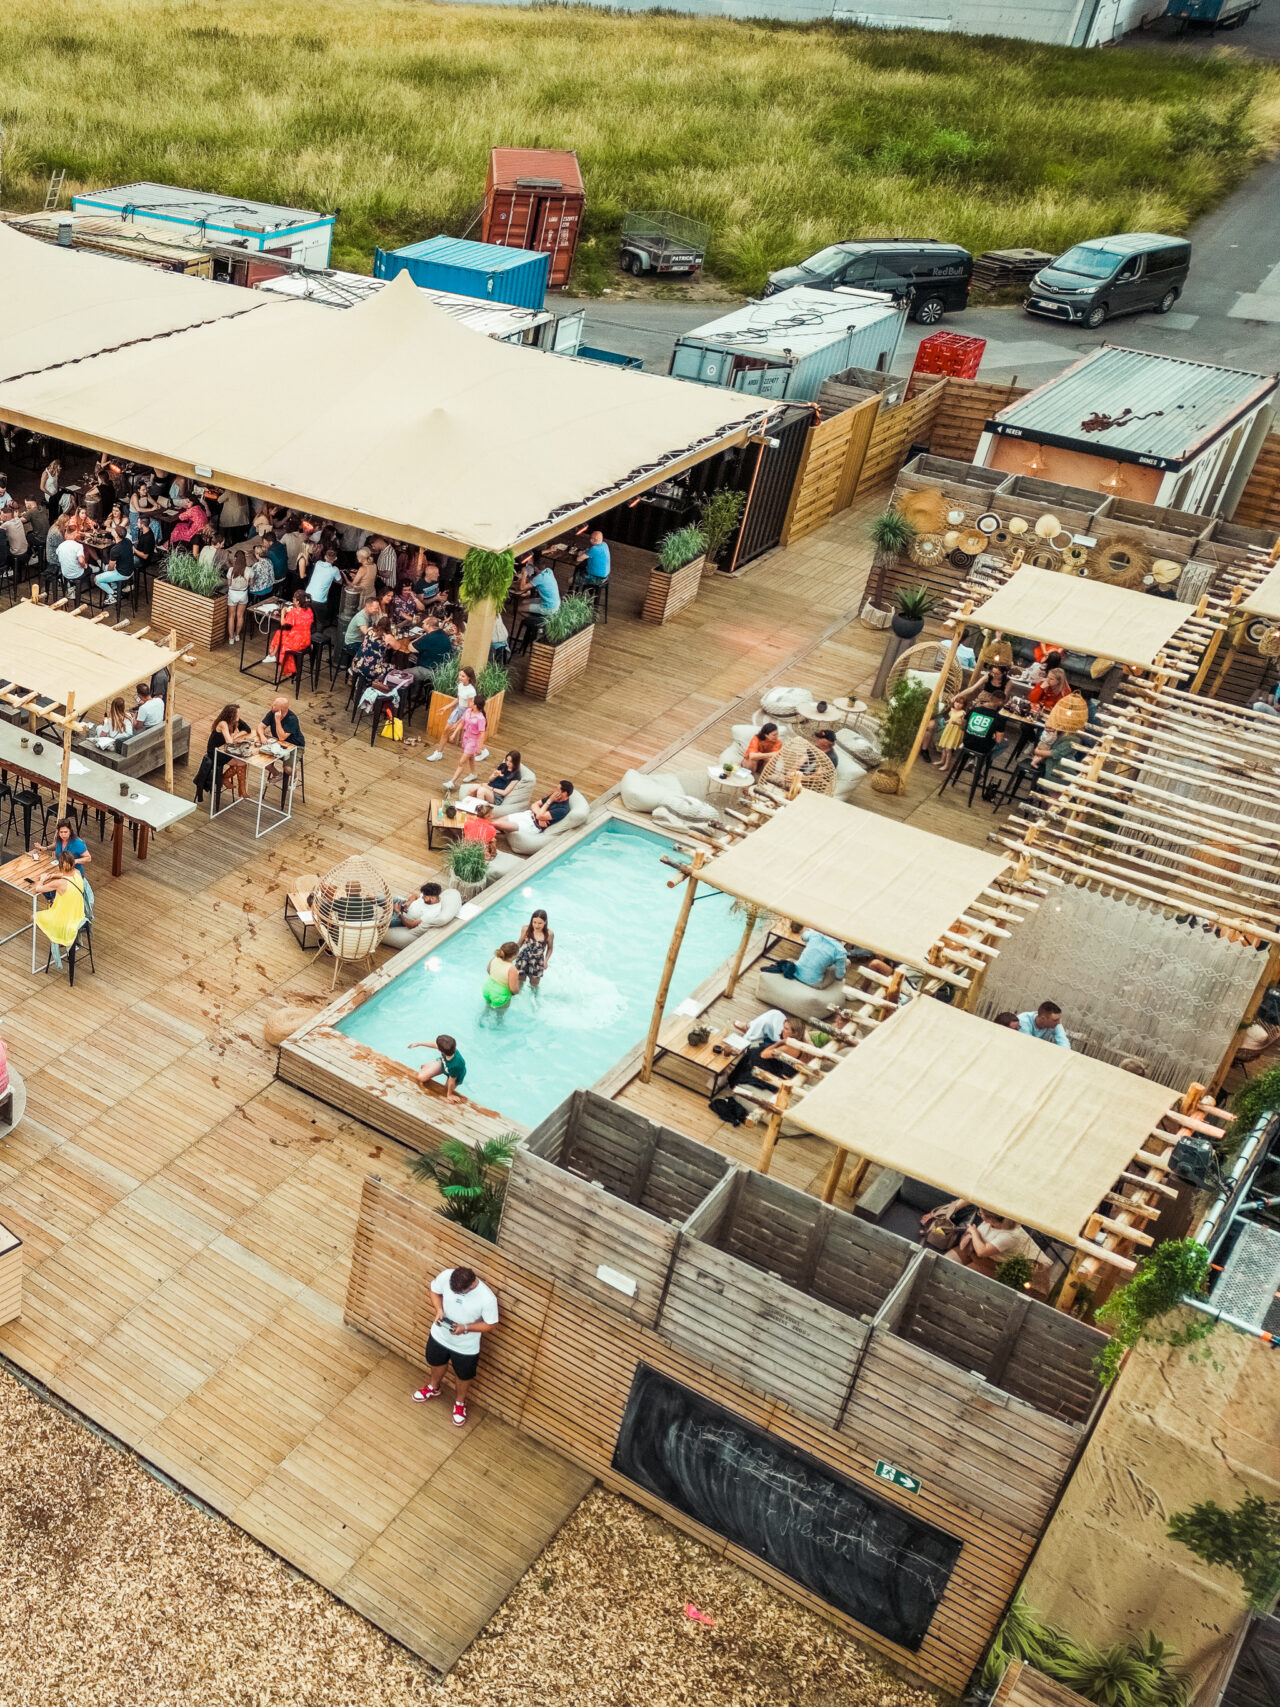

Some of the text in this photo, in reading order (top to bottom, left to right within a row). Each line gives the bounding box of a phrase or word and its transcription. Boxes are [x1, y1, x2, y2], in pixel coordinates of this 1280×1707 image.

[933, 265, 964, 276] Red Bull
[1006, 428, 1023, 436] HEREN
[1139, 457, 1158, 466] DAMES
